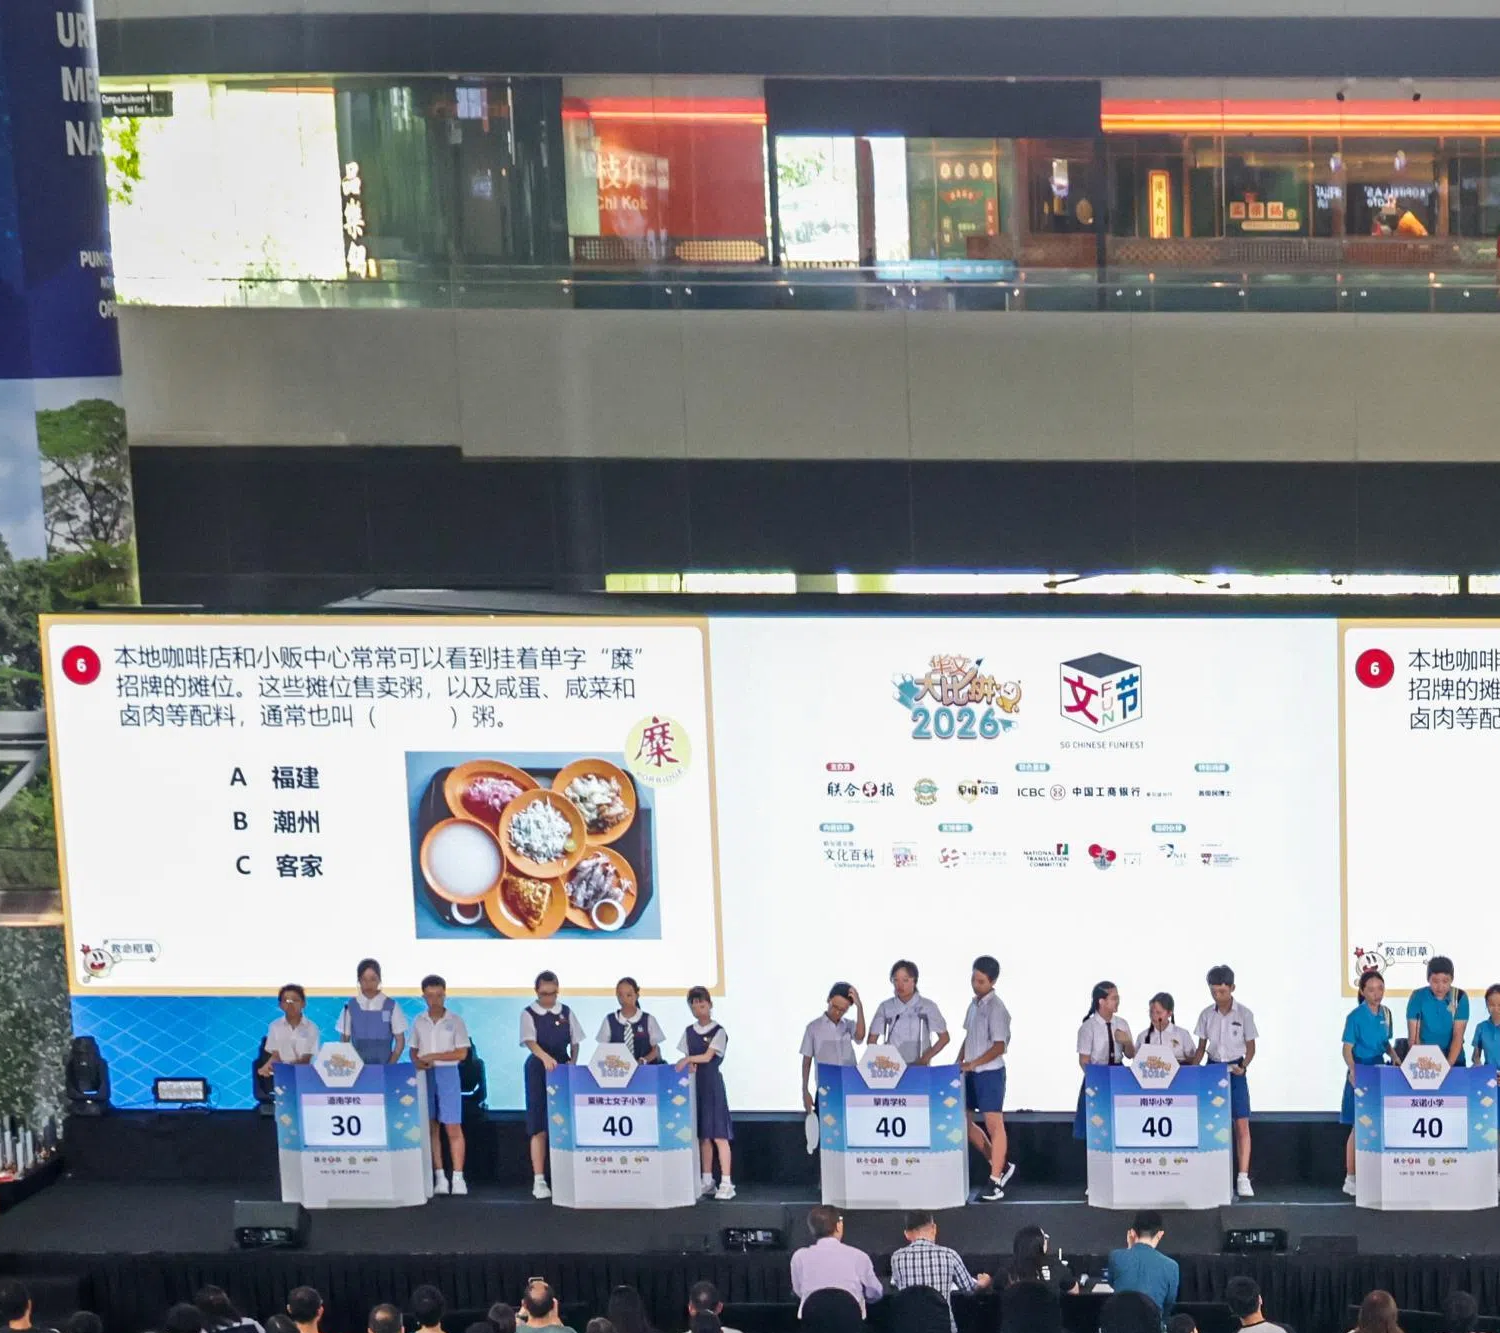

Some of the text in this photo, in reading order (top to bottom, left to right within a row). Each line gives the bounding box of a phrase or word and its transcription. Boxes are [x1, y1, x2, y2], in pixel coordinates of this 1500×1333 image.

[75, 657, 88, 673] 6
[1062, 675, 1099, 726] 文
[1115, 673, 1141, 720] 节
[911, 706, 1002, 742] 2026
[1072, 740, 1106, 750] CHINESE
[1108, 740, 1144, 750] FUNFEST
[229, 765, 321, 791] A 福建
[1016, 787, 1046, 798] ICBC
[233, 809, 321, 834] B 潮州
[235, 854, 324, 879] C 客家
[330, 1114, 363, 1137] 30
[601, 1114, 634, 1138] 40
[874, 1116, 907, 1139] 40
[1141, 1115, 1174, 1139] 40
[1411, 1117, 1445, 1140] 40
